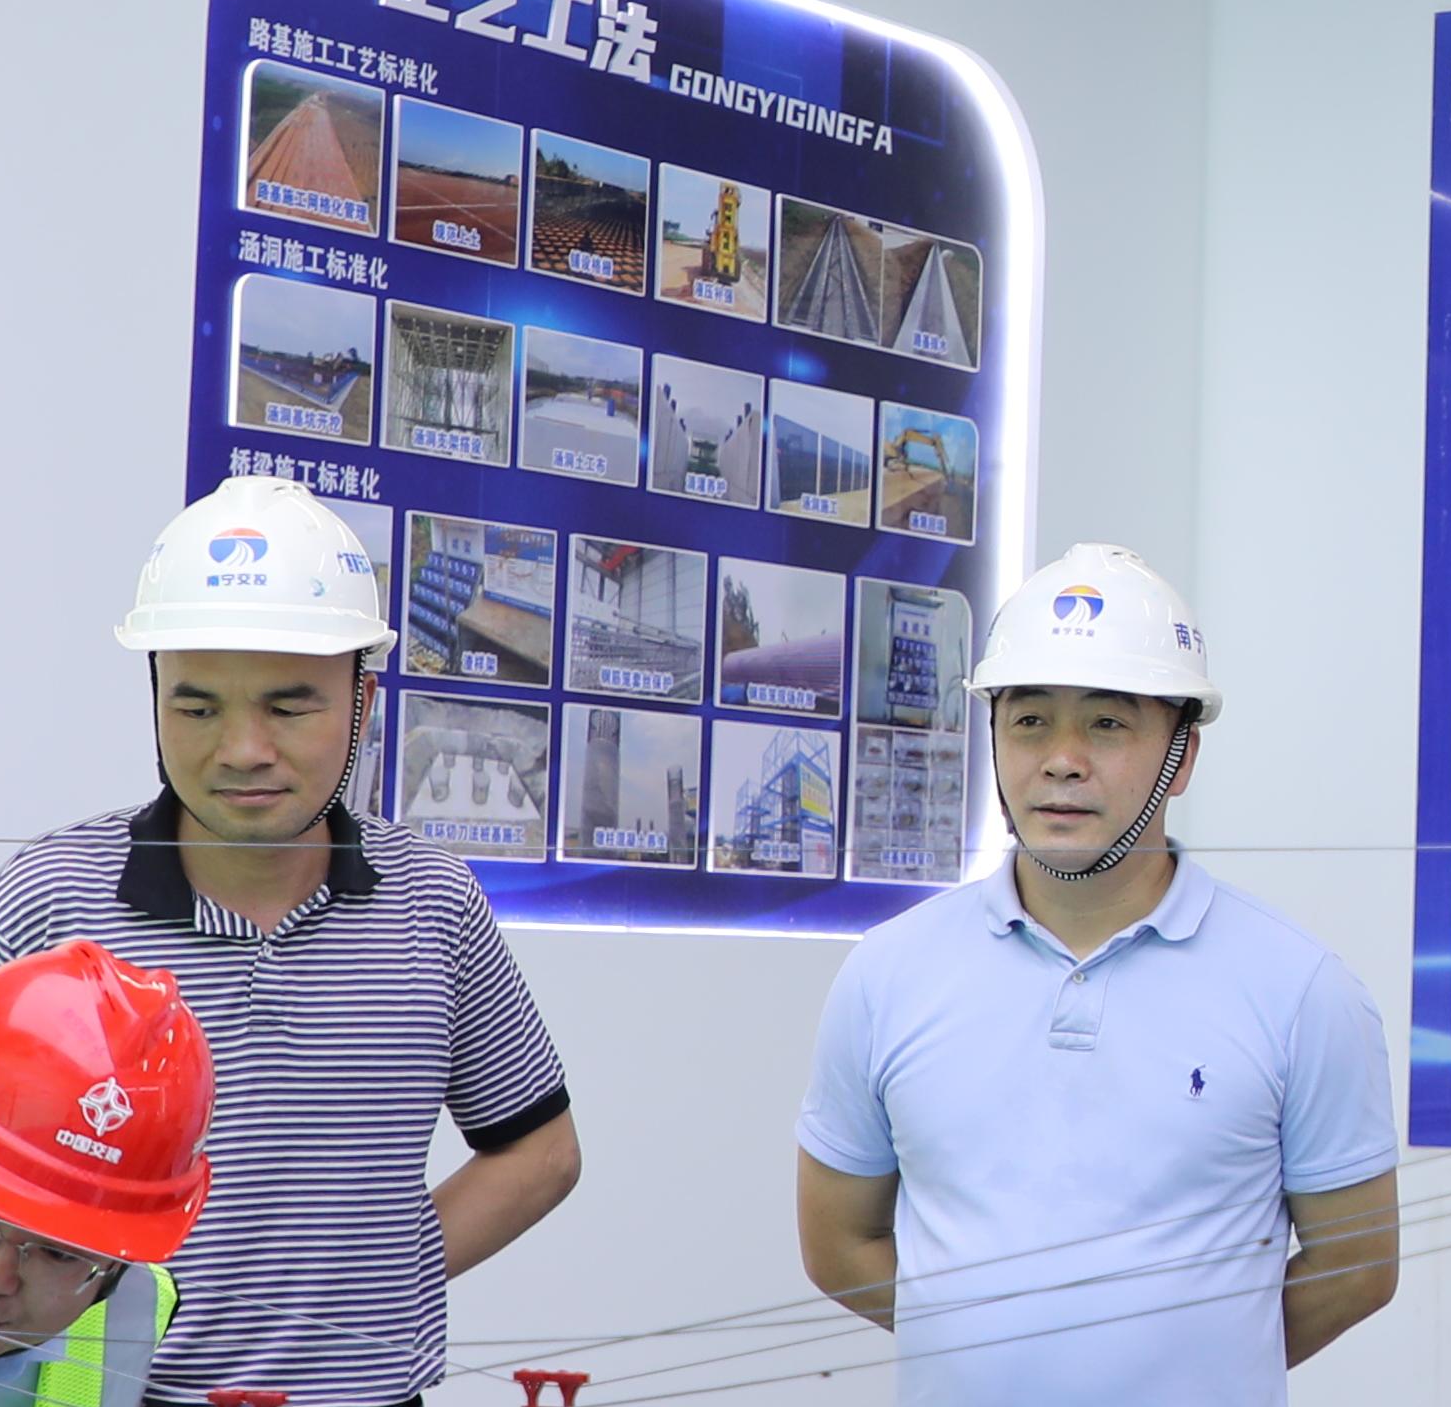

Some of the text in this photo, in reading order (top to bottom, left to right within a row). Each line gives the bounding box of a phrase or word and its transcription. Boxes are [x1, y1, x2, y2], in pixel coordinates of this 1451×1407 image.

[248, 17, 438, 94] 路基施工工艺标准化
[670, 64, 893, 154] GONGYIGINGFA
[238, 230, 389, 290] 涵洞施工标准化
[55, 1129, 124, 1165] 中国交建
